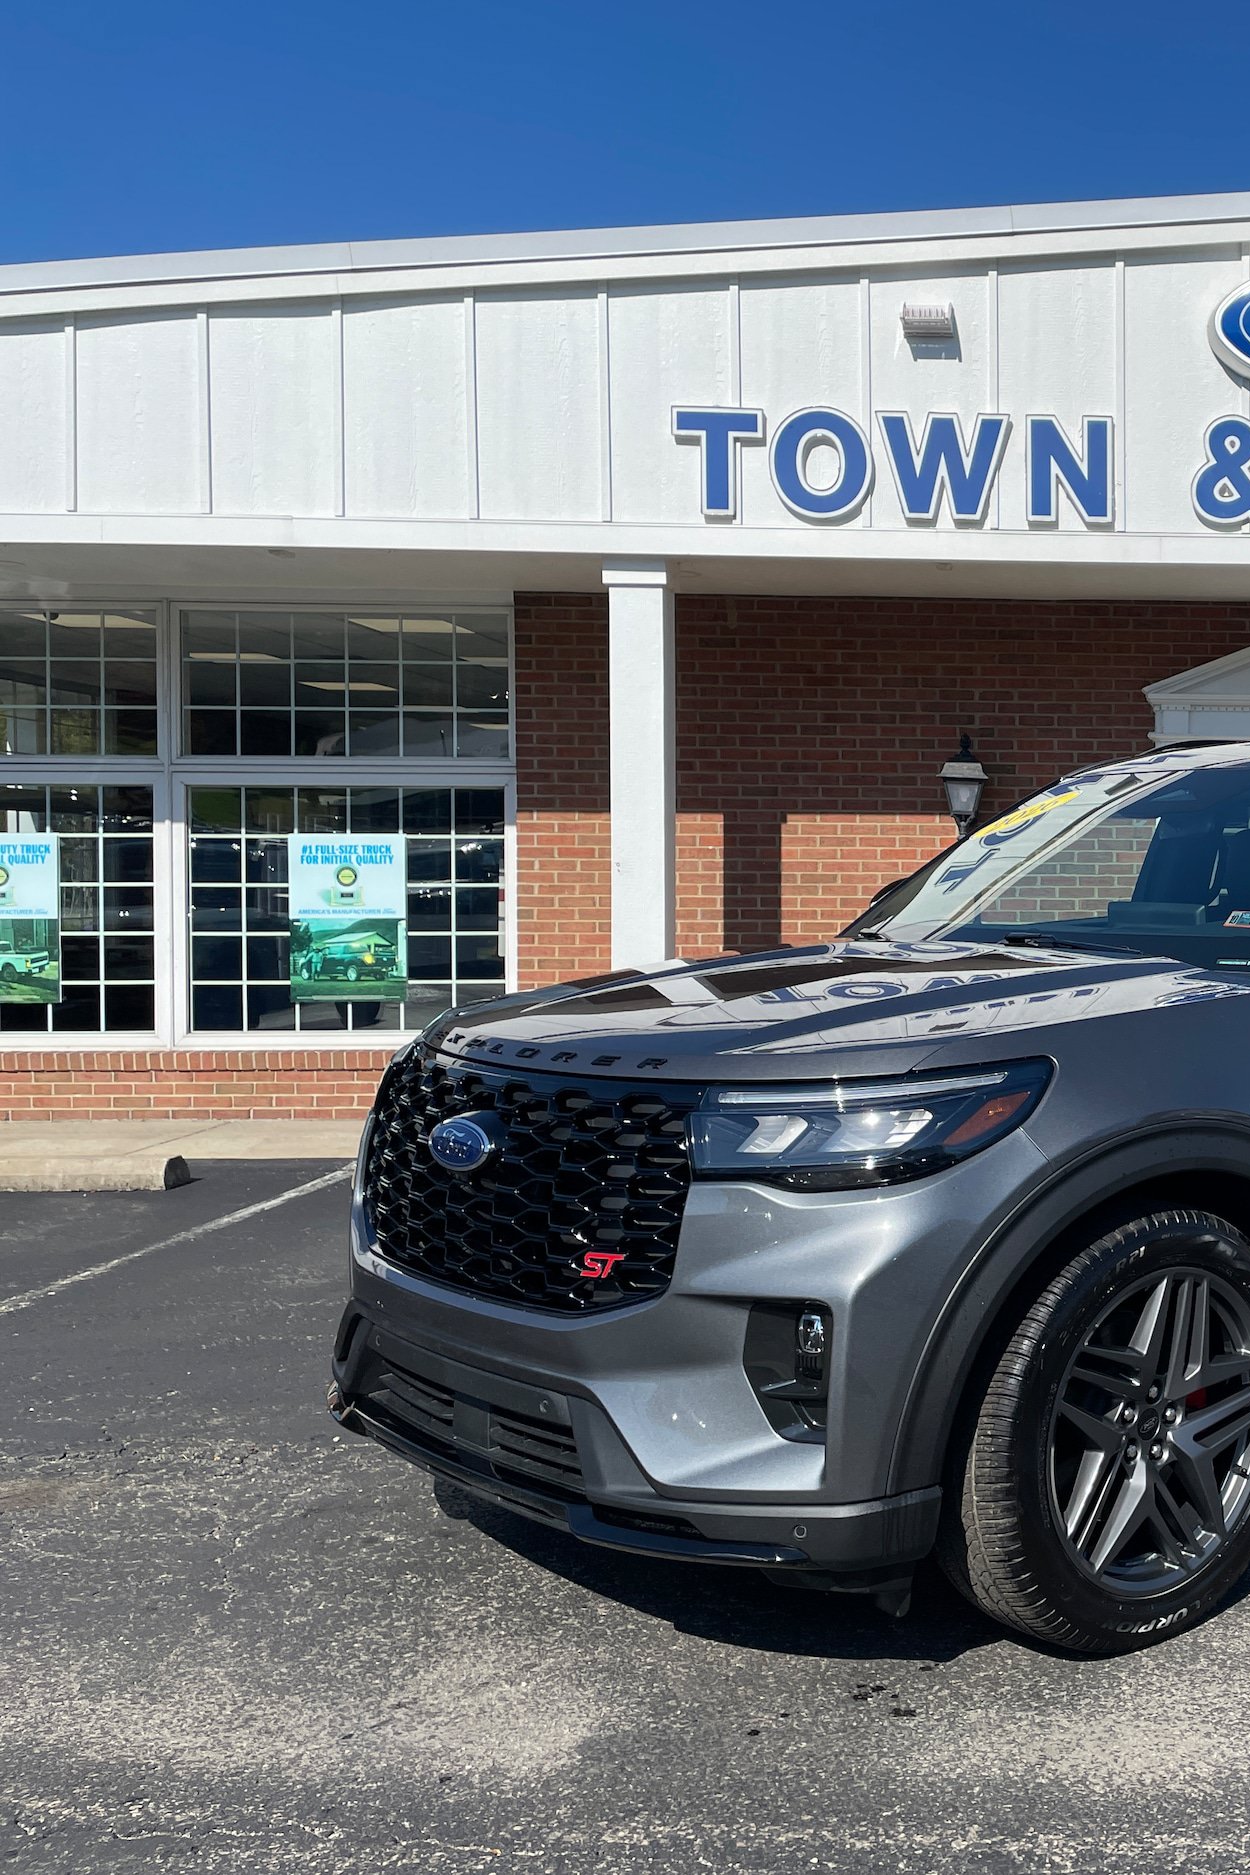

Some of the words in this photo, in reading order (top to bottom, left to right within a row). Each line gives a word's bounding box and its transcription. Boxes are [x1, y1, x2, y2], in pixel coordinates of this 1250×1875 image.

[671, 405, 1114, 522] TOWN
[0, 844, 17, 854] UTY
[20, 844, 51, 854] TRUCK
[301, 845, 313, 854] #1
[315, 845, 359, 854] FULL-SIZE
[361, 845, 392, 854] TRUCK
[8, 854, 46, 866] QUALITY
[300, 855, 319, 864] FOR
[321, 855, 353, 864] INITIAL
[355, 855, 394, 866] QUALITY
[580, 1252, 624, 1278] ST
